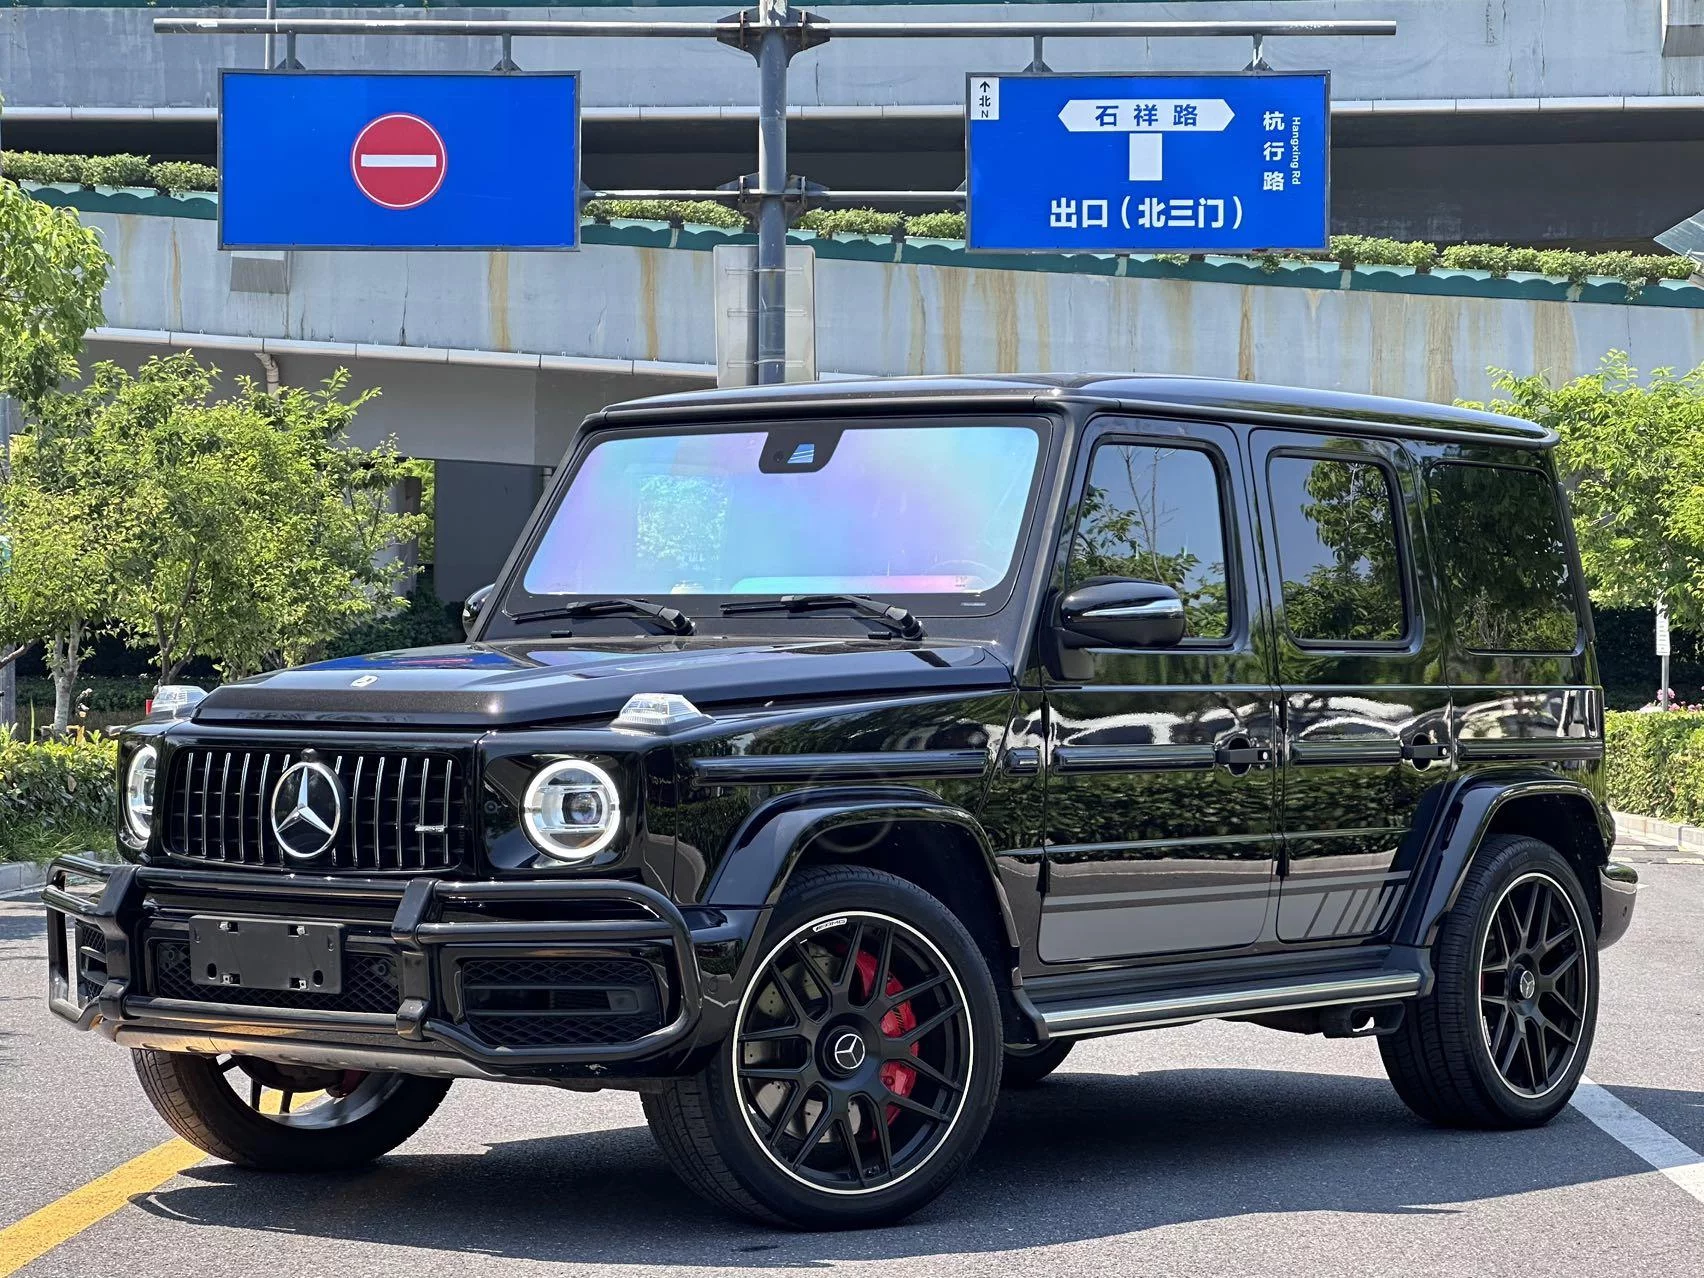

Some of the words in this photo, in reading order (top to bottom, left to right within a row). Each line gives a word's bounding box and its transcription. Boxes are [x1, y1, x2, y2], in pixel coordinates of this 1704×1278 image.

[979, 95, 991, 107] 北
[981, 110, 989, 119] N
[1095, 104, 1198, 127] 石祥路
[1263, 111, 1285, 191] 杭行路
[1290, 117, 1301, 169] Hangxing
[1291, 170, 1301, 185] Rd
